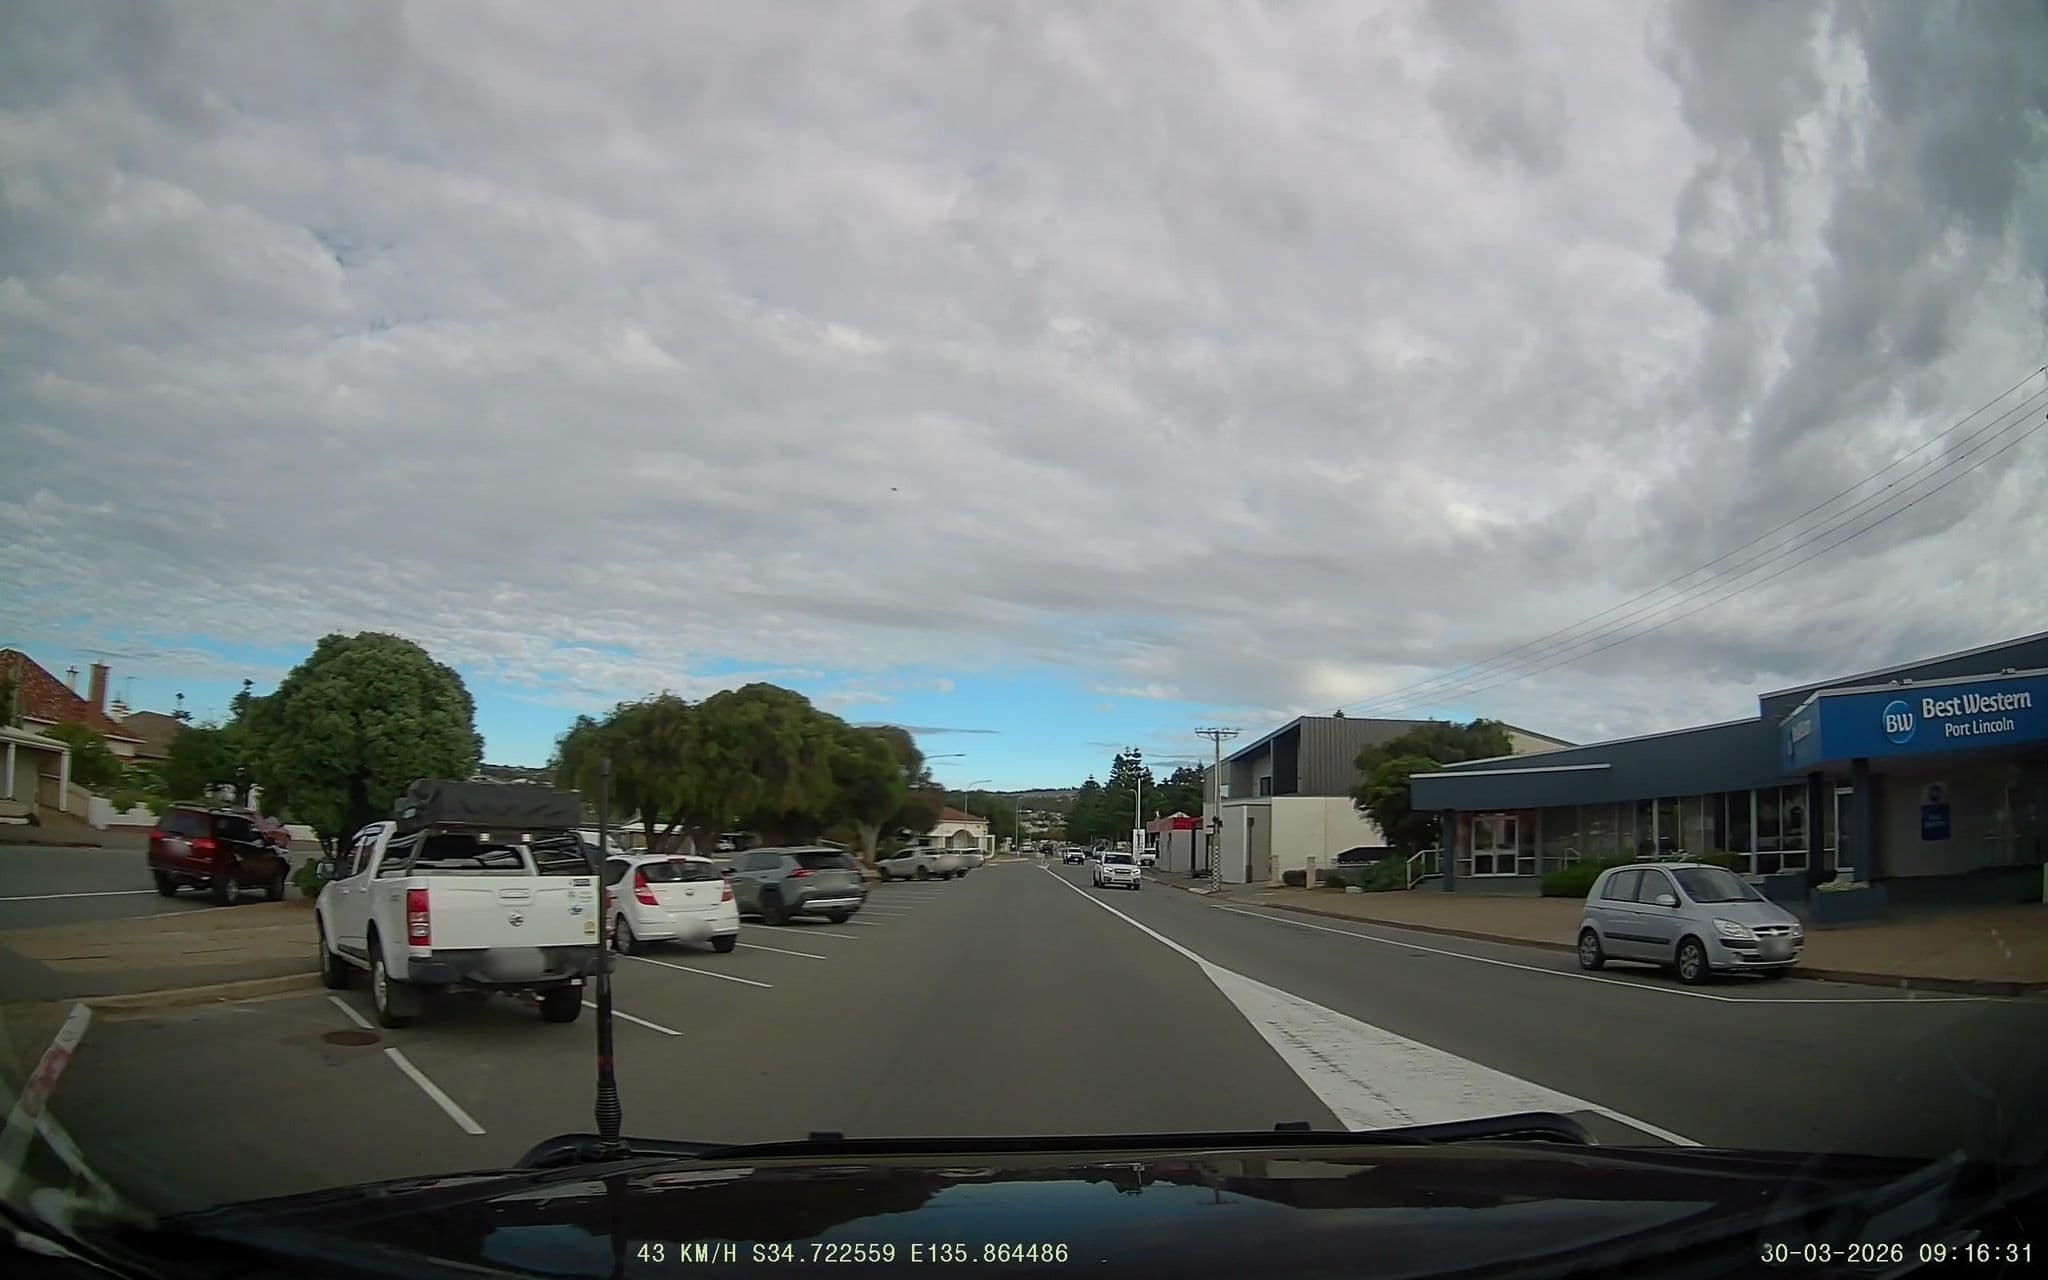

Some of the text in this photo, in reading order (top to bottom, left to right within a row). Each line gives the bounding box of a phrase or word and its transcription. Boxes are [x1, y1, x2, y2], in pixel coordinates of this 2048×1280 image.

[1922, 691, 2032, 719] Best Western
[1886, 713, 1913, 733] BW
[1945, 717, 2015, 737] Port Lincoln
